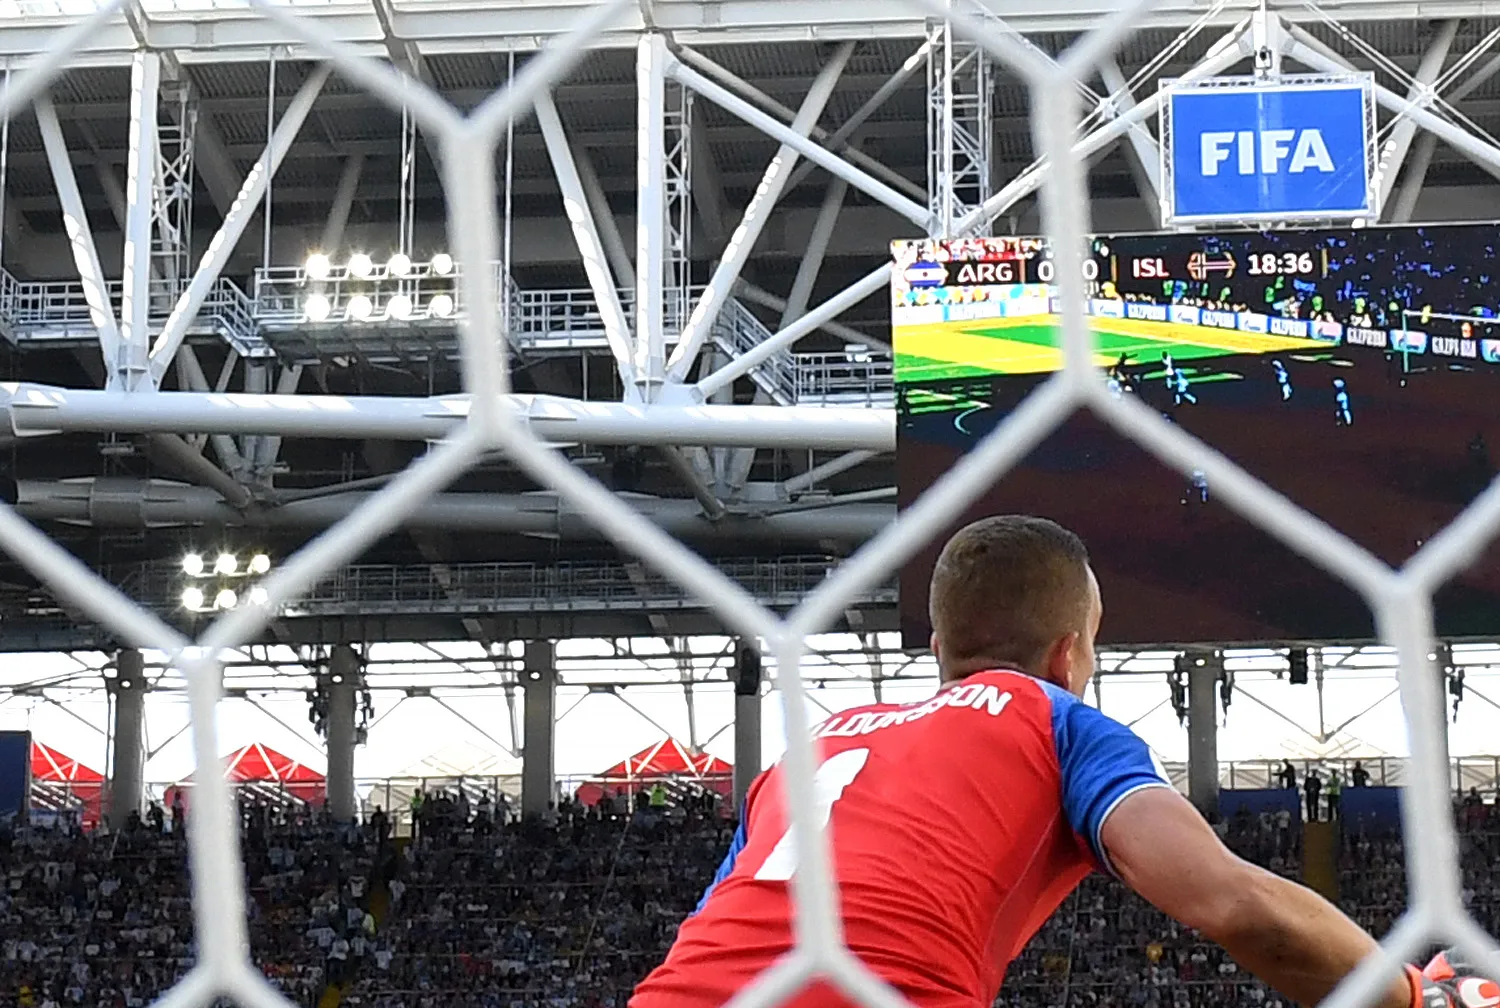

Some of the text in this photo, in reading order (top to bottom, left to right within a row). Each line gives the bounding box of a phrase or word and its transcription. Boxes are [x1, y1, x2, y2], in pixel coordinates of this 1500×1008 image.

[1201, 128, 1335, 176] FIFA
[957, 252, 1313, 283] ARG 0 0 ISL 18:36
